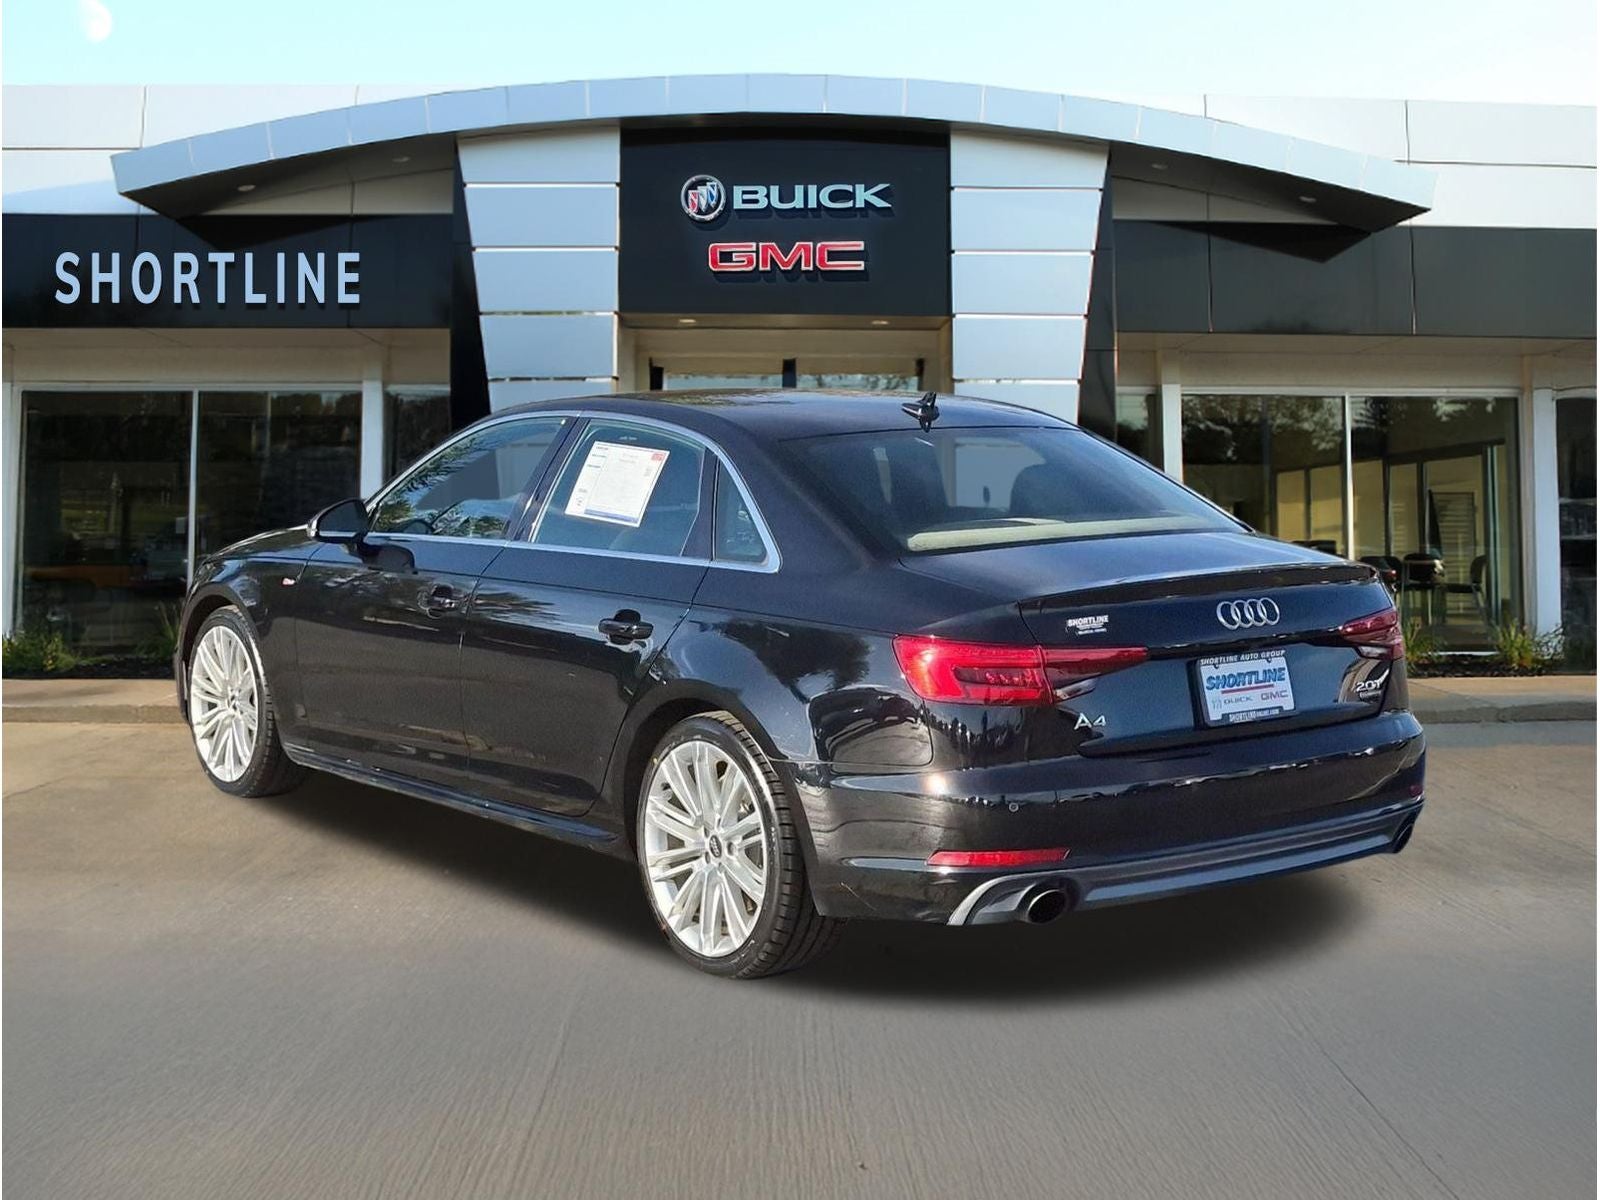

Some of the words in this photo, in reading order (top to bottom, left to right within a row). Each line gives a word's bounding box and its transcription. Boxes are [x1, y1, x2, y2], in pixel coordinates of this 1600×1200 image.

[733, 184, 892, 210] BUICK
[708, 241, 865, 271] GMC
[55, 251, 361, 305] SHORTLINE
[1067, 615, 1109, 627] SHORTLINE
[1200, 655, 1238, 665] SHORTLINE
[1240, 653, 1259, 661] AUTO
[1261, 650, 1285, 658] GROUP
[1205, 667, 1286, 690] SHORTLINE
[1260, 689, 1289, 701] GMC
[1073, 712, 1107, 730] A4
